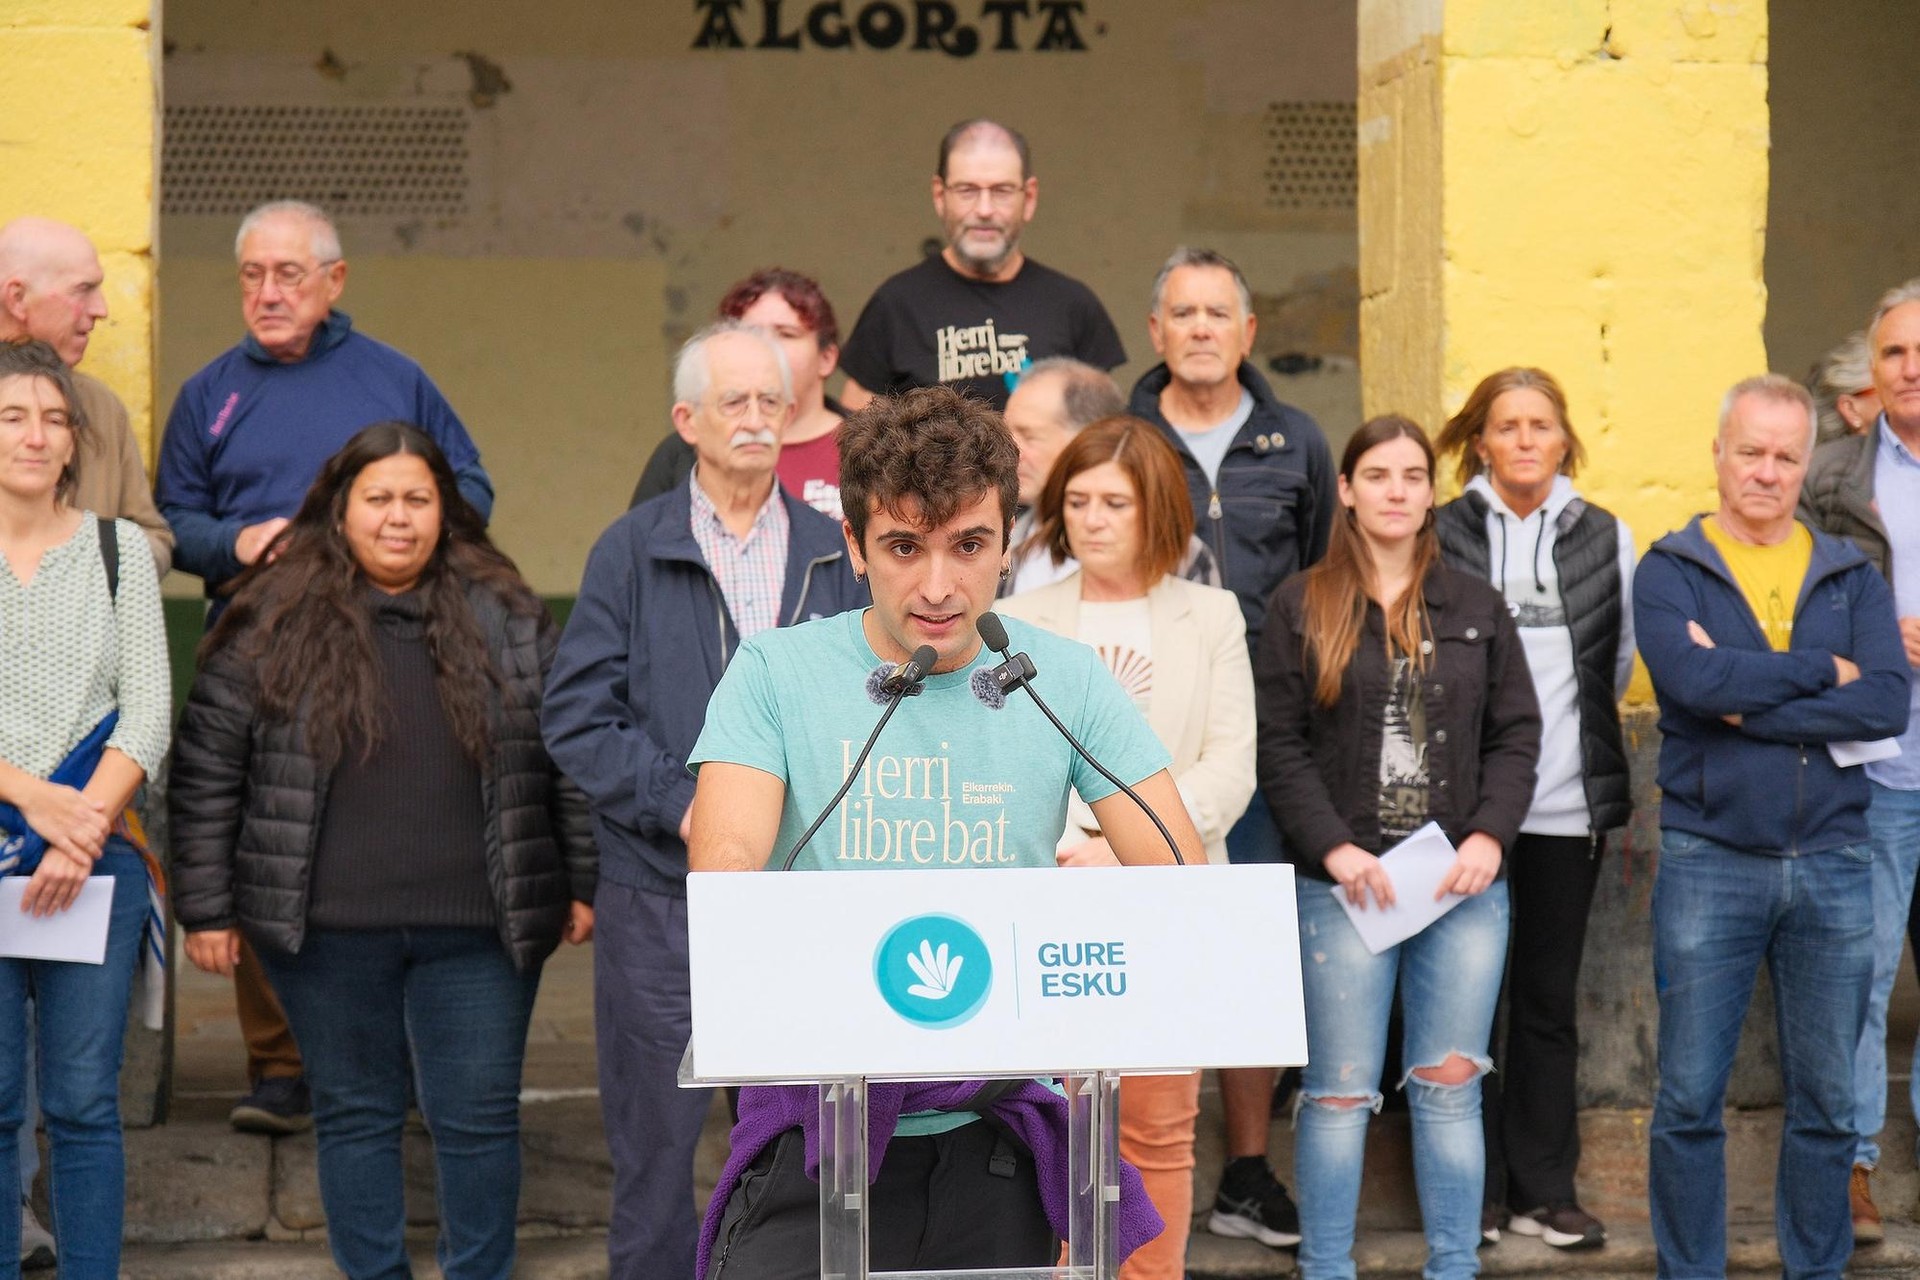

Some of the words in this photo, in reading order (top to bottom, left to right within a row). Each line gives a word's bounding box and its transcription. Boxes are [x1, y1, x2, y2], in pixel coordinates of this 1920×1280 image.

[691, 0, 1088, 57] ALGORTA
[937, 318, 997, 350] Herri
[839, 739, 953, 801] Herri
[962, 781, 1016, 793] Elkarrekin.
[962, 793, 1005, 805] Erabaki.
[1038, 942, 1126, 967] GURE
[1041, 972, 1126, 997] ESKU
